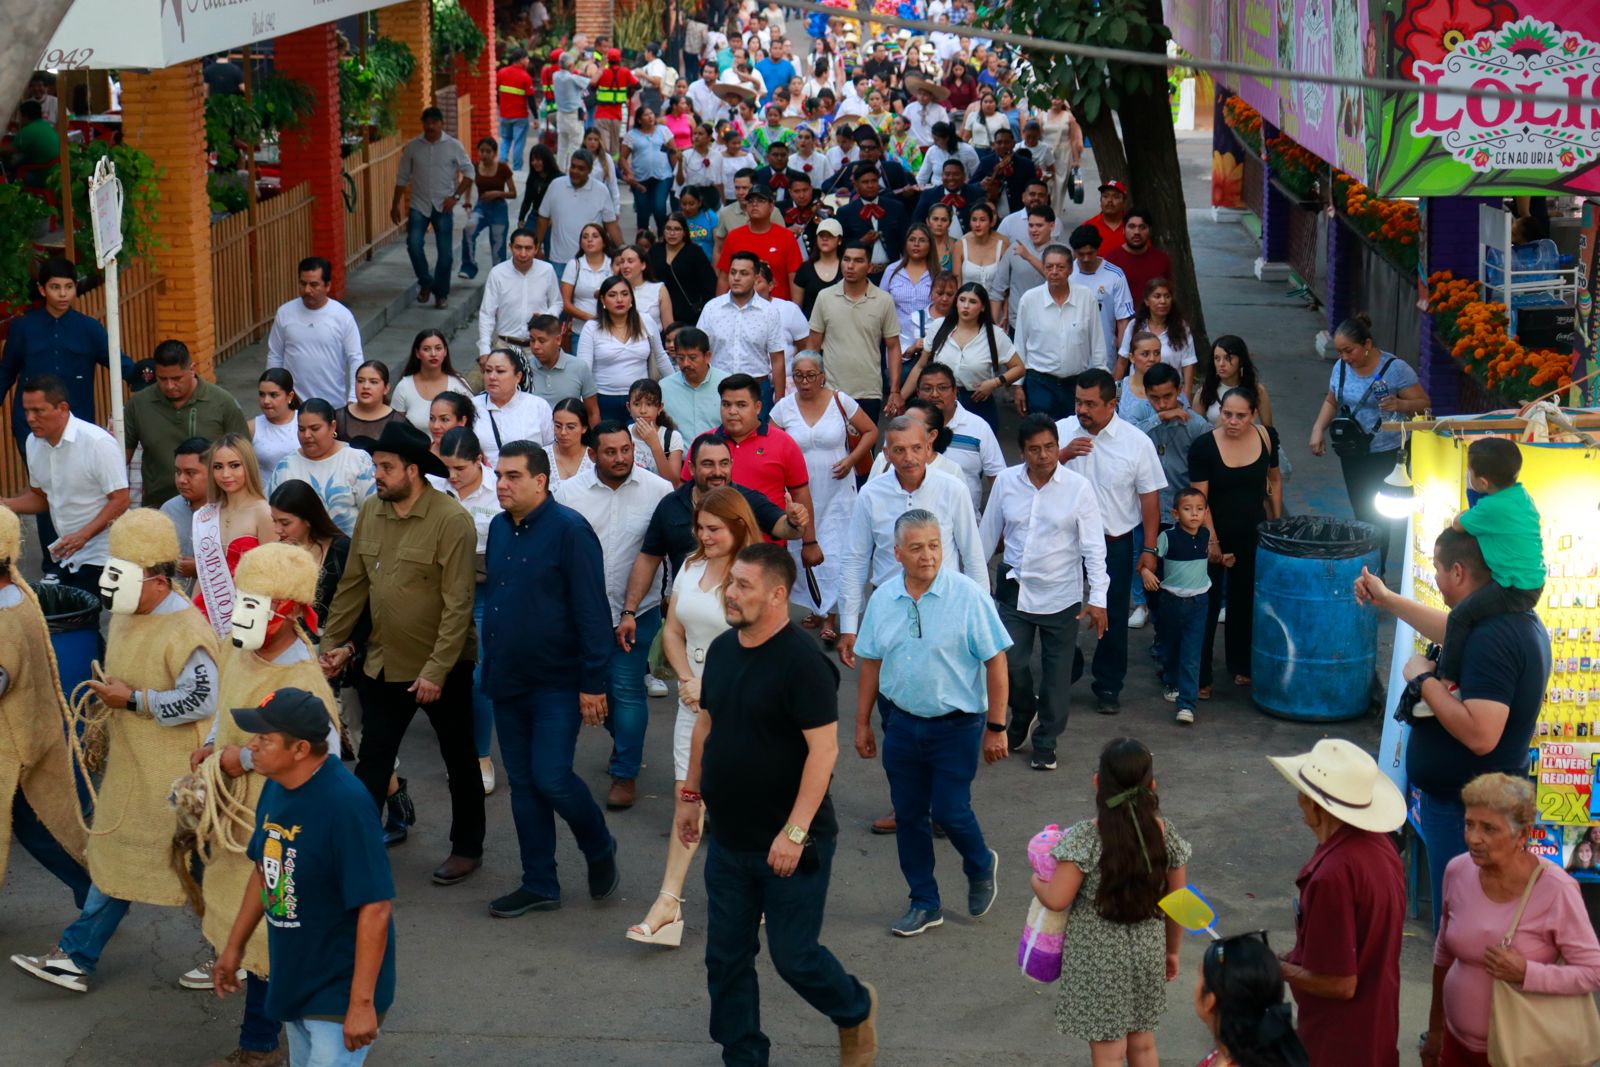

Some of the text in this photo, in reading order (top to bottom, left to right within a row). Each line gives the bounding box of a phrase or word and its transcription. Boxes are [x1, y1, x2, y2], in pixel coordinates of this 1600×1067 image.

[37, 48, 94, 71] 1942
[1495, 151, 1554, 165] CENADURIA
[200, 526, 233, 635] EMBAJADOR
[1543, 744, 1574, 755] FOTO
